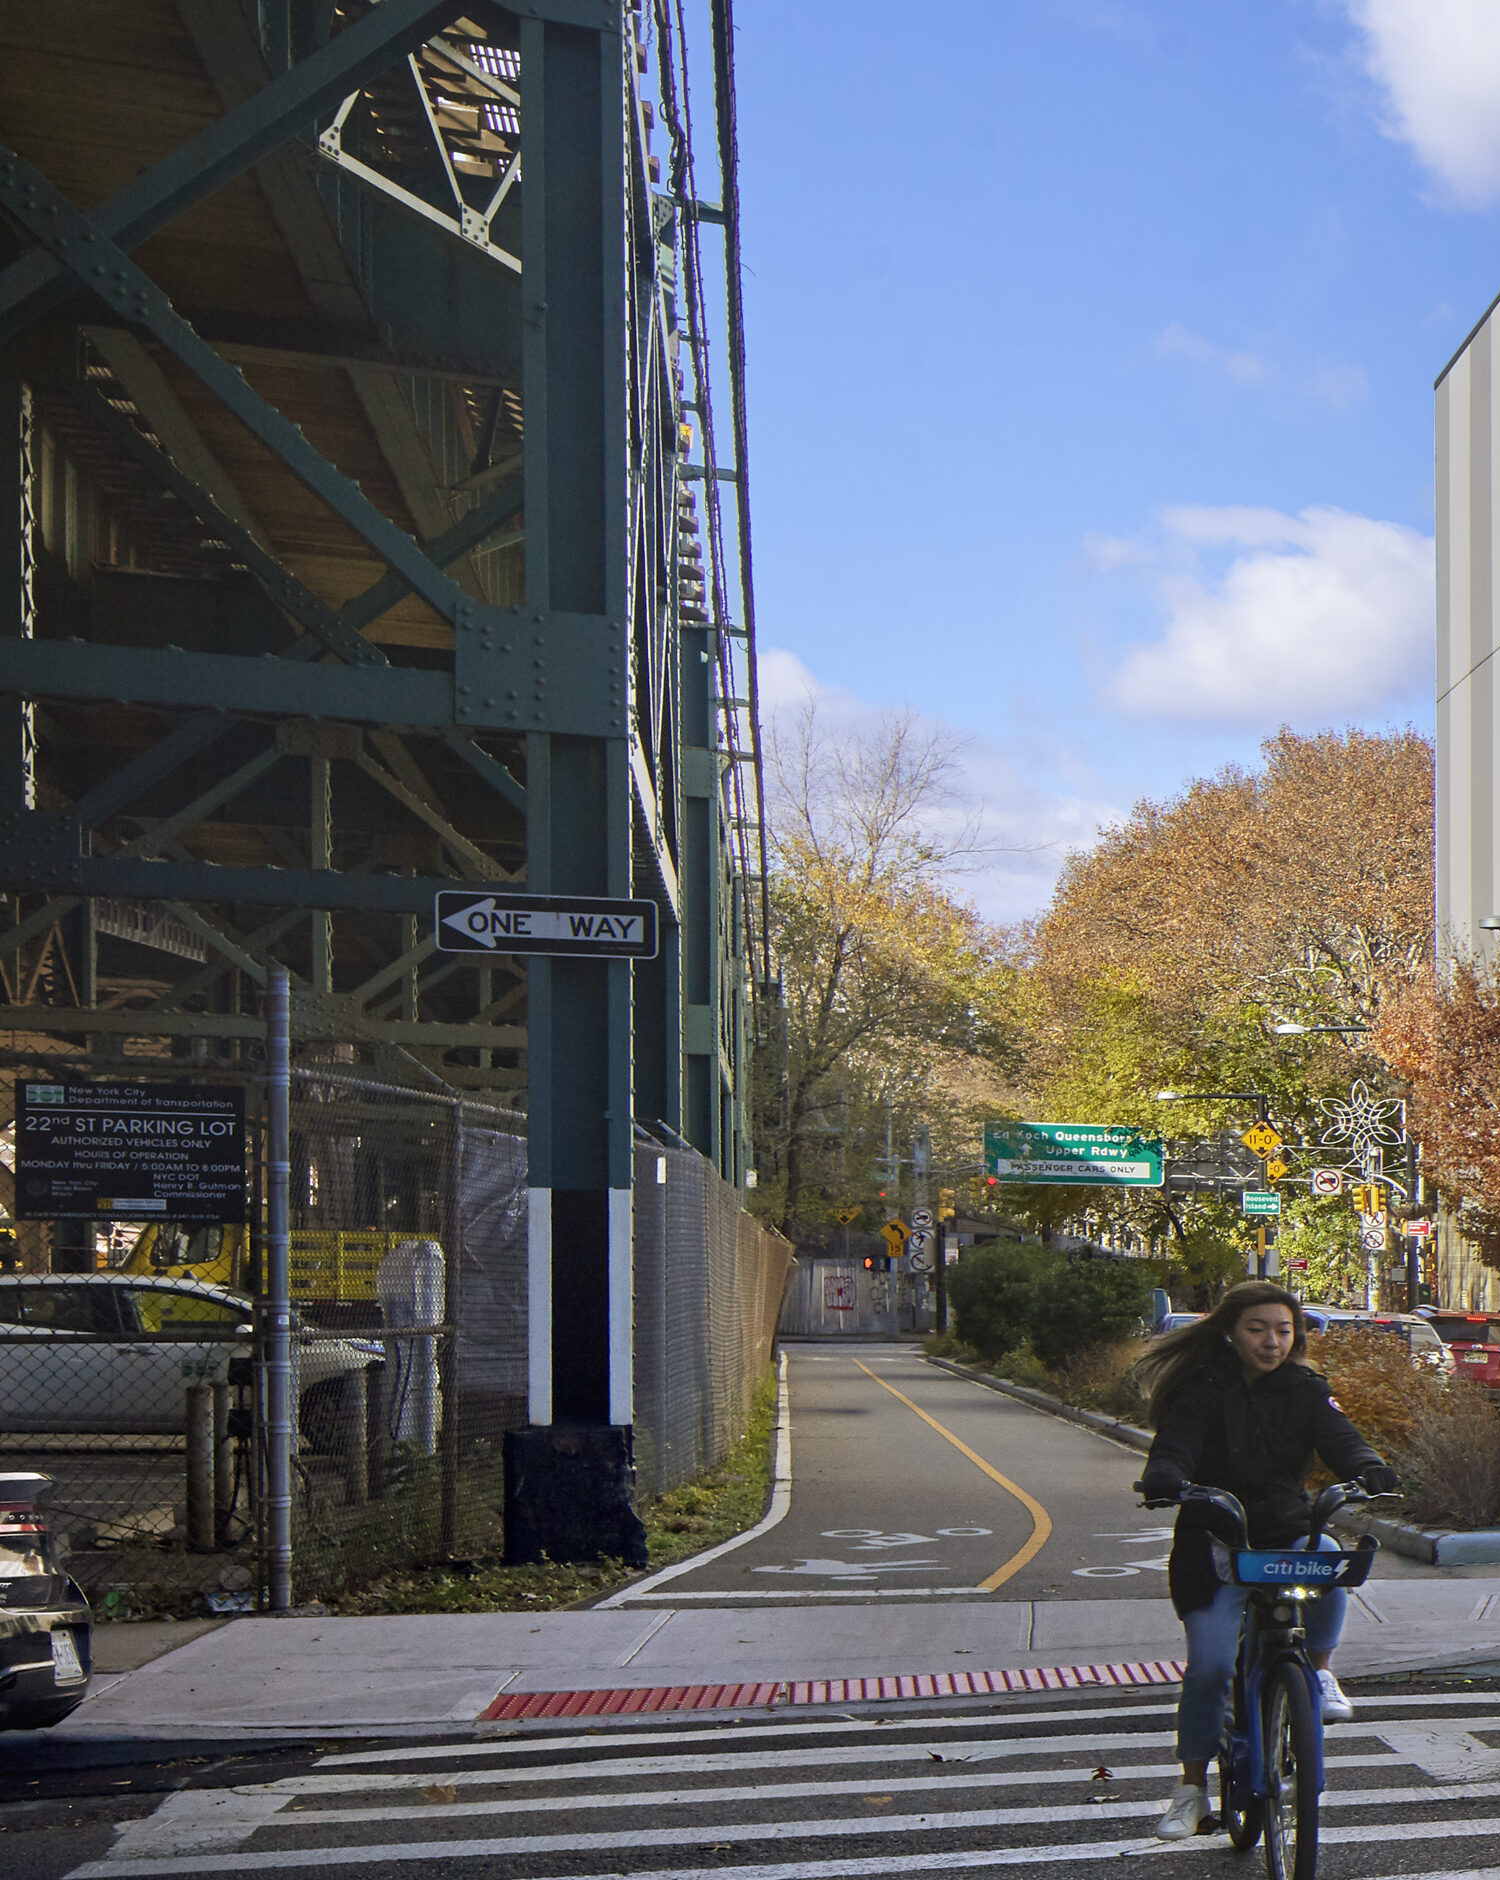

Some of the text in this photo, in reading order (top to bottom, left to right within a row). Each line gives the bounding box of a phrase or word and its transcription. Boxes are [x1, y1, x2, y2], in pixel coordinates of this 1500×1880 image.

[467, 911, 636, 939] ONE WAY
[69, 1086, 146, 1097] New York City
[69, 1095, 233, 1109] Department of Transportation
[25, 1115, 236, 1136] 22nd ST PARKING LOT
[51, 1136, 212, 1148] AUTHORIZED VEHICLES ONLY
[74, 1151, 189, 1161] HOURS OF OPERATION
[1046, 1145, 1128, 1159] Upper Rdwy
[21, 1160, 70, 1169] MONDAY
[72, 1161, 92, 1169] thru
[95, 1162, 131, 1170] FRIDAY
[1078, 1165, 1106, 1173] CARS
[1110, 1166, 1136, 1174] ONLY
[153, 1173, 175, 1181] NYC
[153, 1181, 183, 1190] Henry
[199, 1182, 241, 1191] Gutman
[153, 1190, 226, 1199] Commissioner
[1264, 1560, 1332, 1576] citi bike
